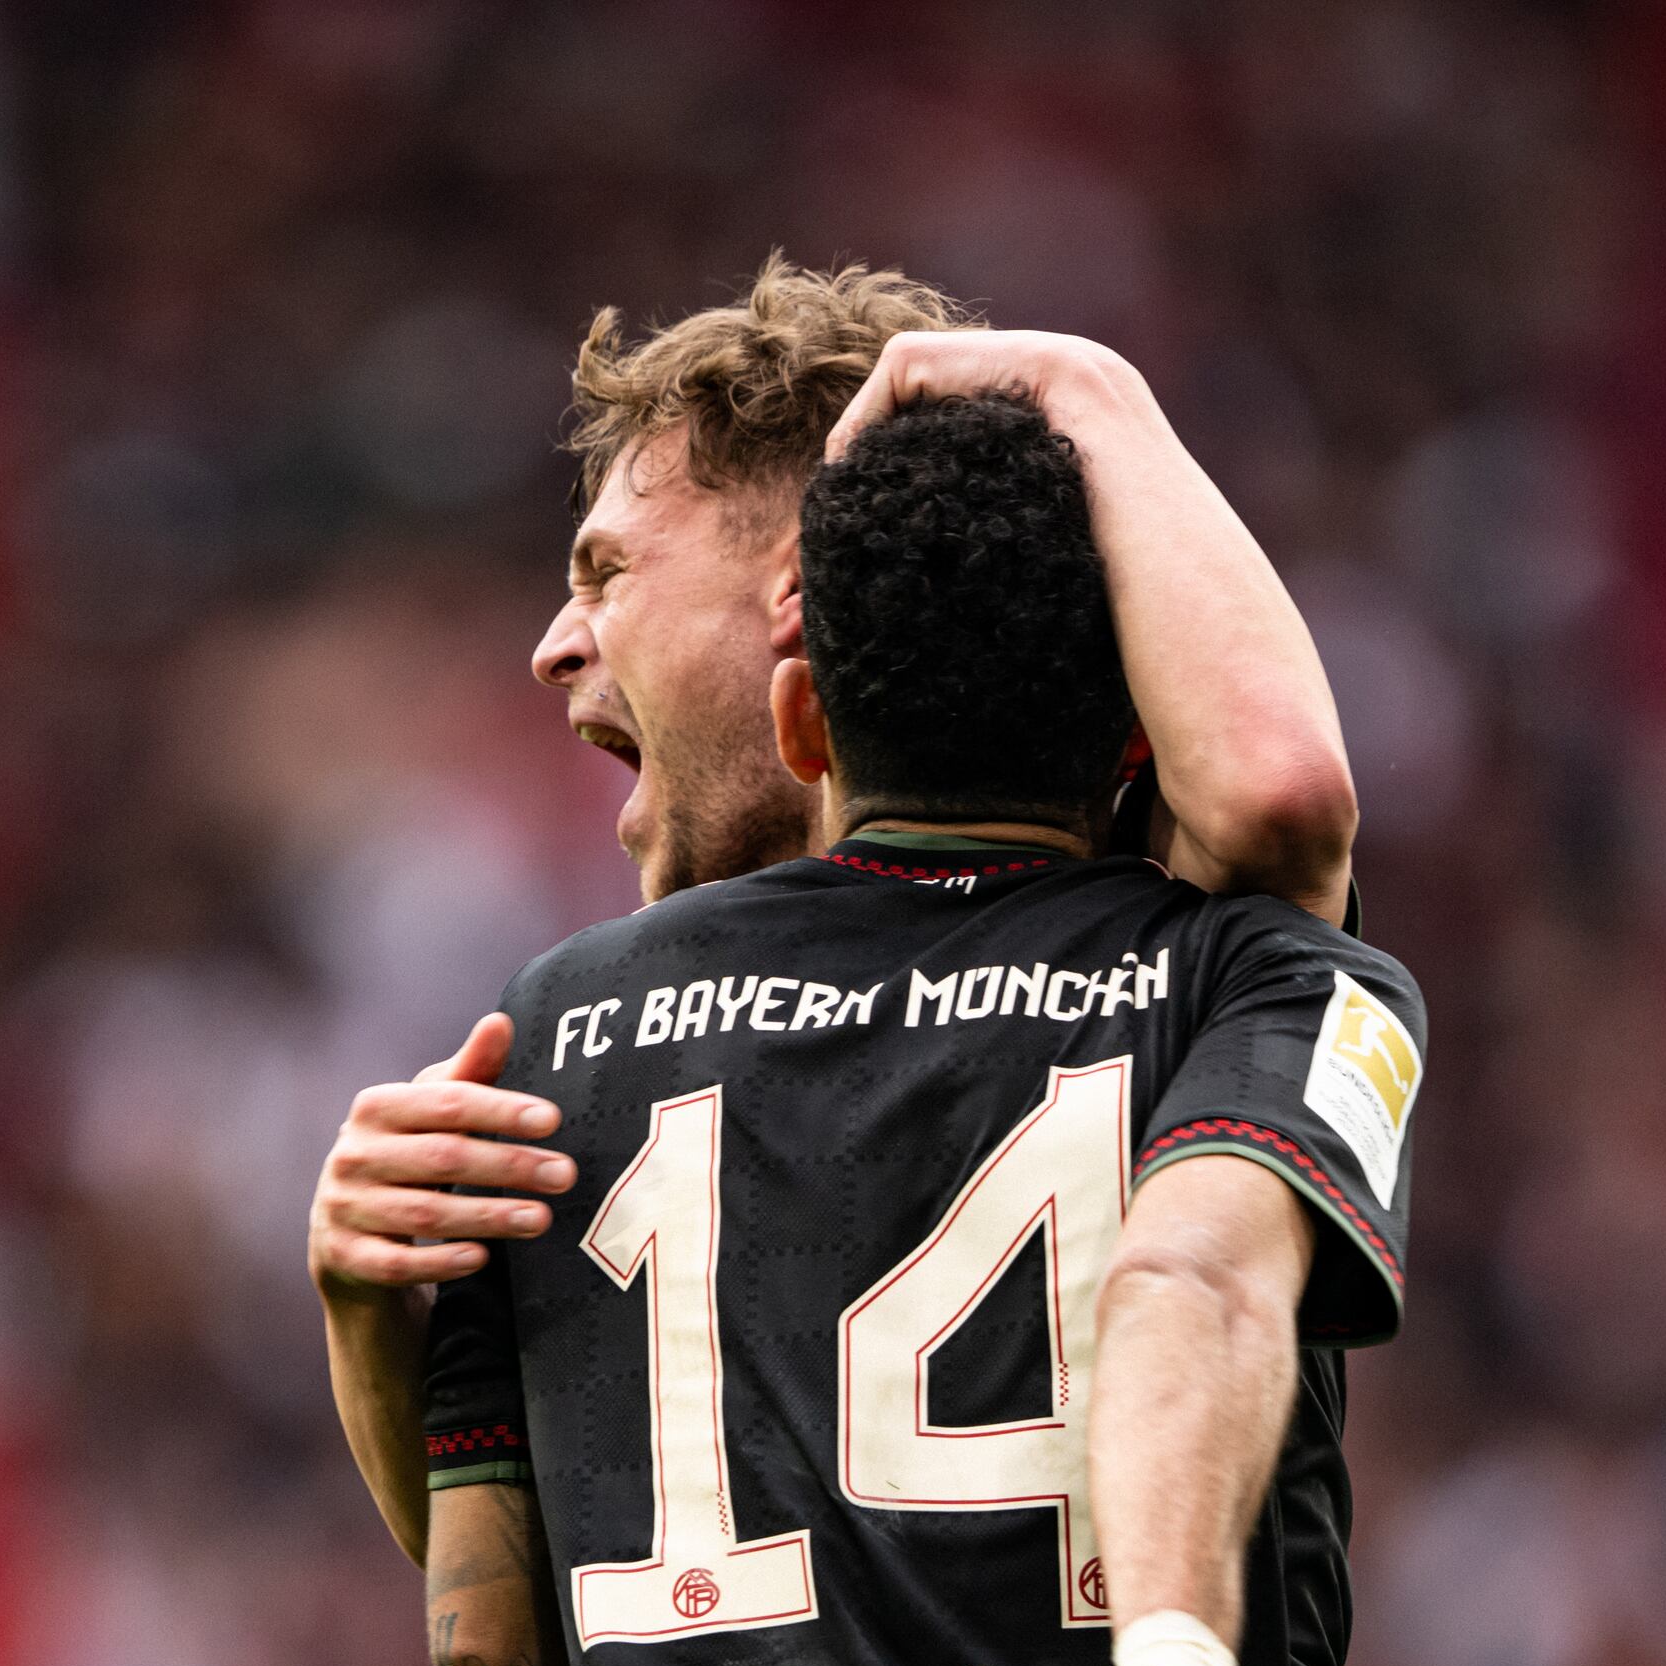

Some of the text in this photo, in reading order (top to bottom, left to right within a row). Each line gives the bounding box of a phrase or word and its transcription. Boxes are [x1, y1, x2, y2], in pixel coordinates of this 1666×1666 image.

[552, 998, 622, 1071] FC
[634, 976, 885, 1047] BAYERN
[571, 1054, 1133, 1652] 14
